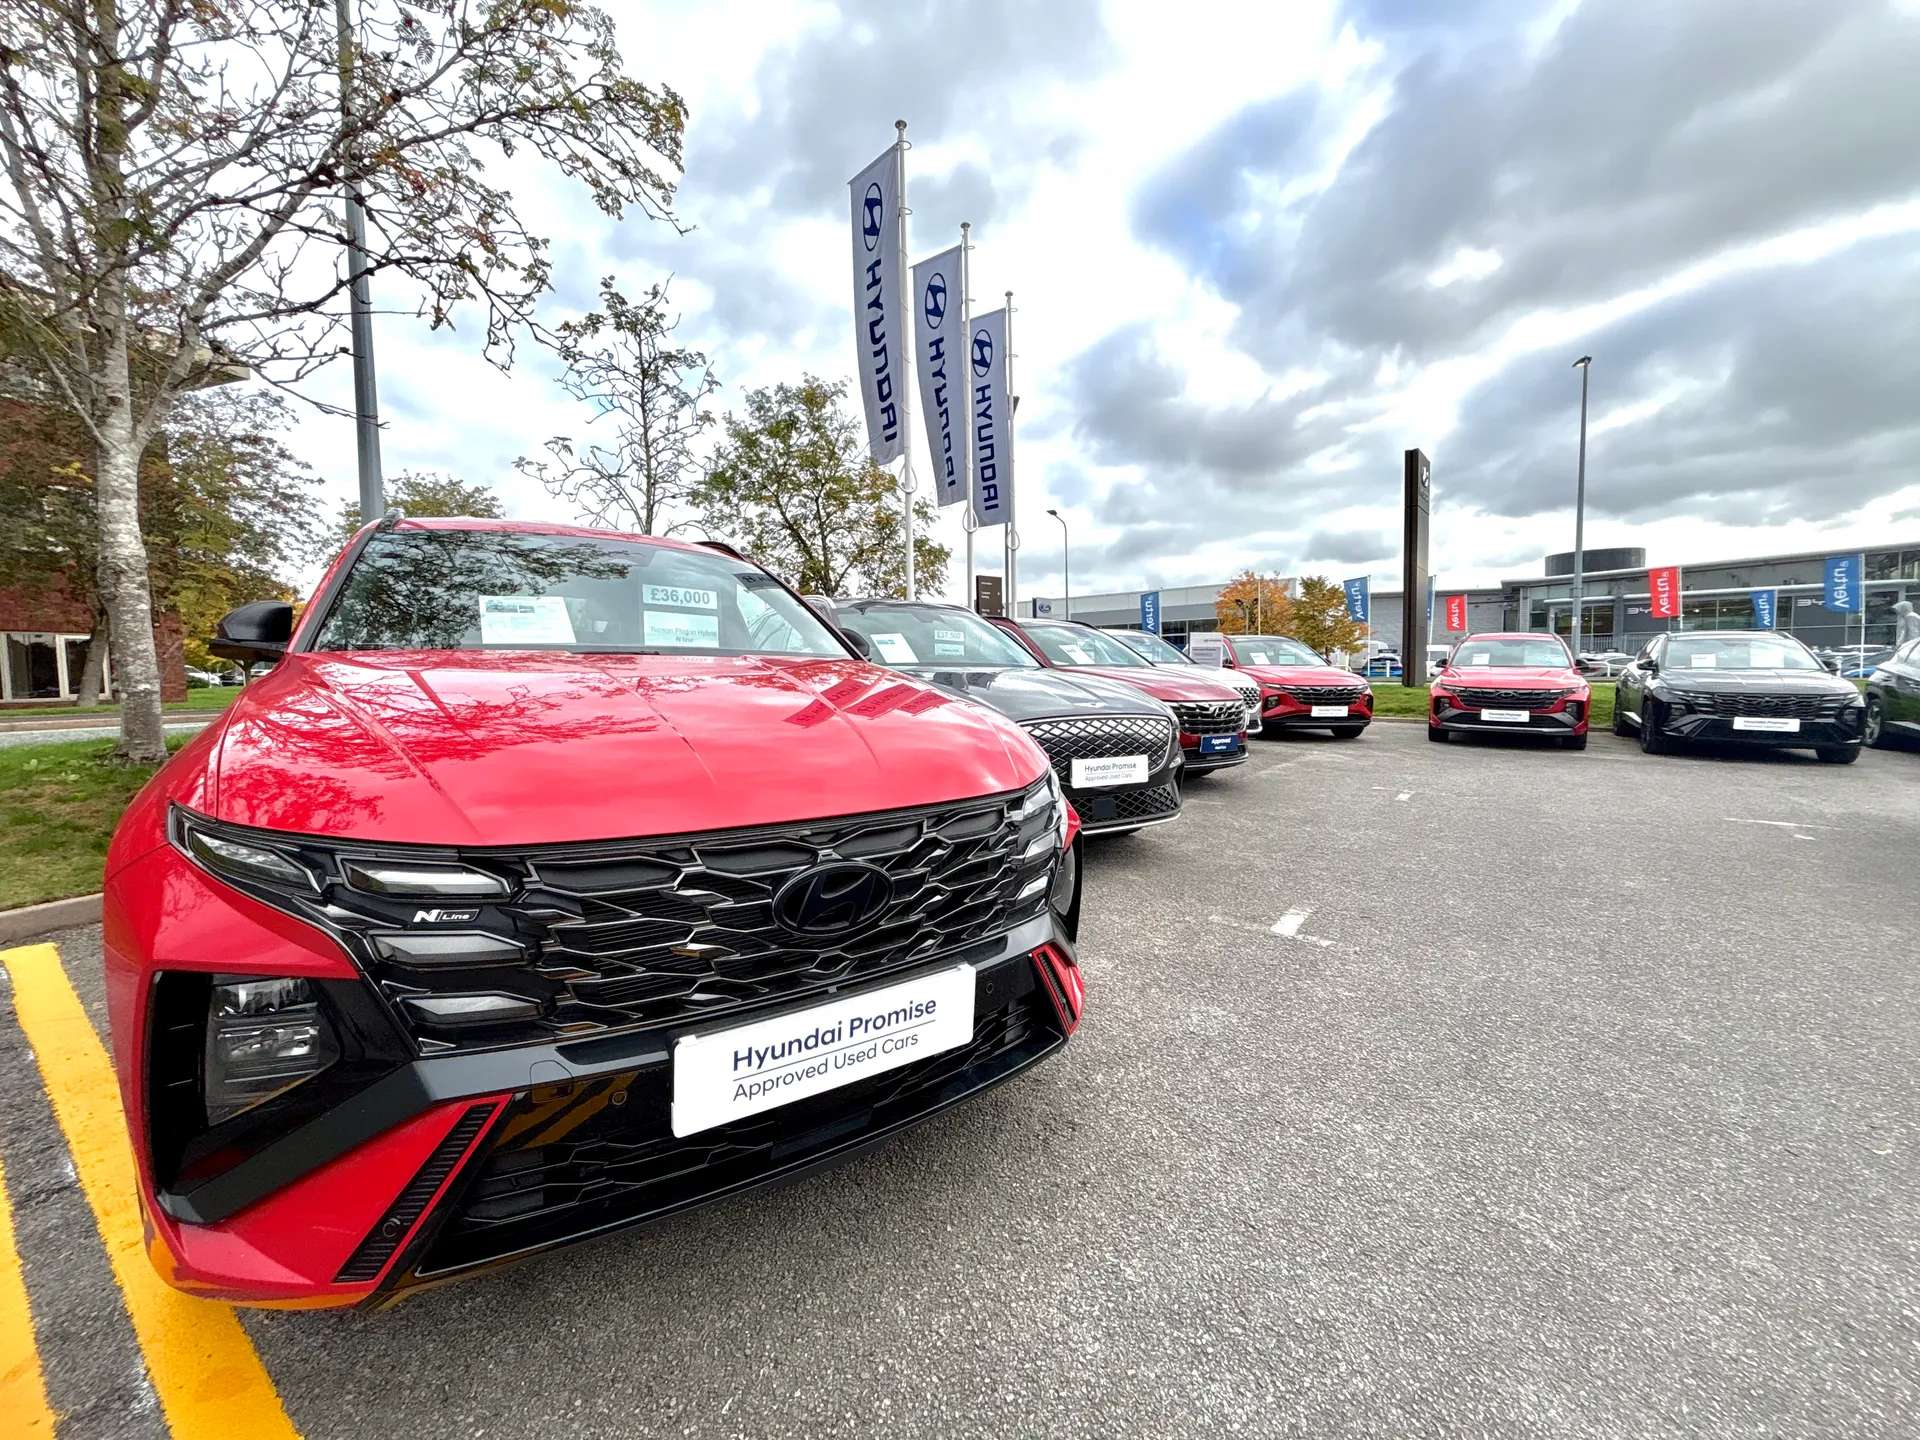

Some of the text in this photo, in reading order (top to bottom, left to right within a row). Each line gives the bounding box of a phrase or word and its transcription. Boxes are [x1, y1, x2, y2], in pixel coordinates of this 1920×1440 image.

[864, 258, 898, 443] HYUNDAI
[928, 336, 957, 488] HYUNDAI
[975, 384, 999, 511] HYUNDAI
[650, 588, 710, 605] £36,000
[413, 909, 440, 922] N
[733, 998, 937, 1072] Hyundai Promise
[733, 1032, 919, 1102] Approved Used Cars
